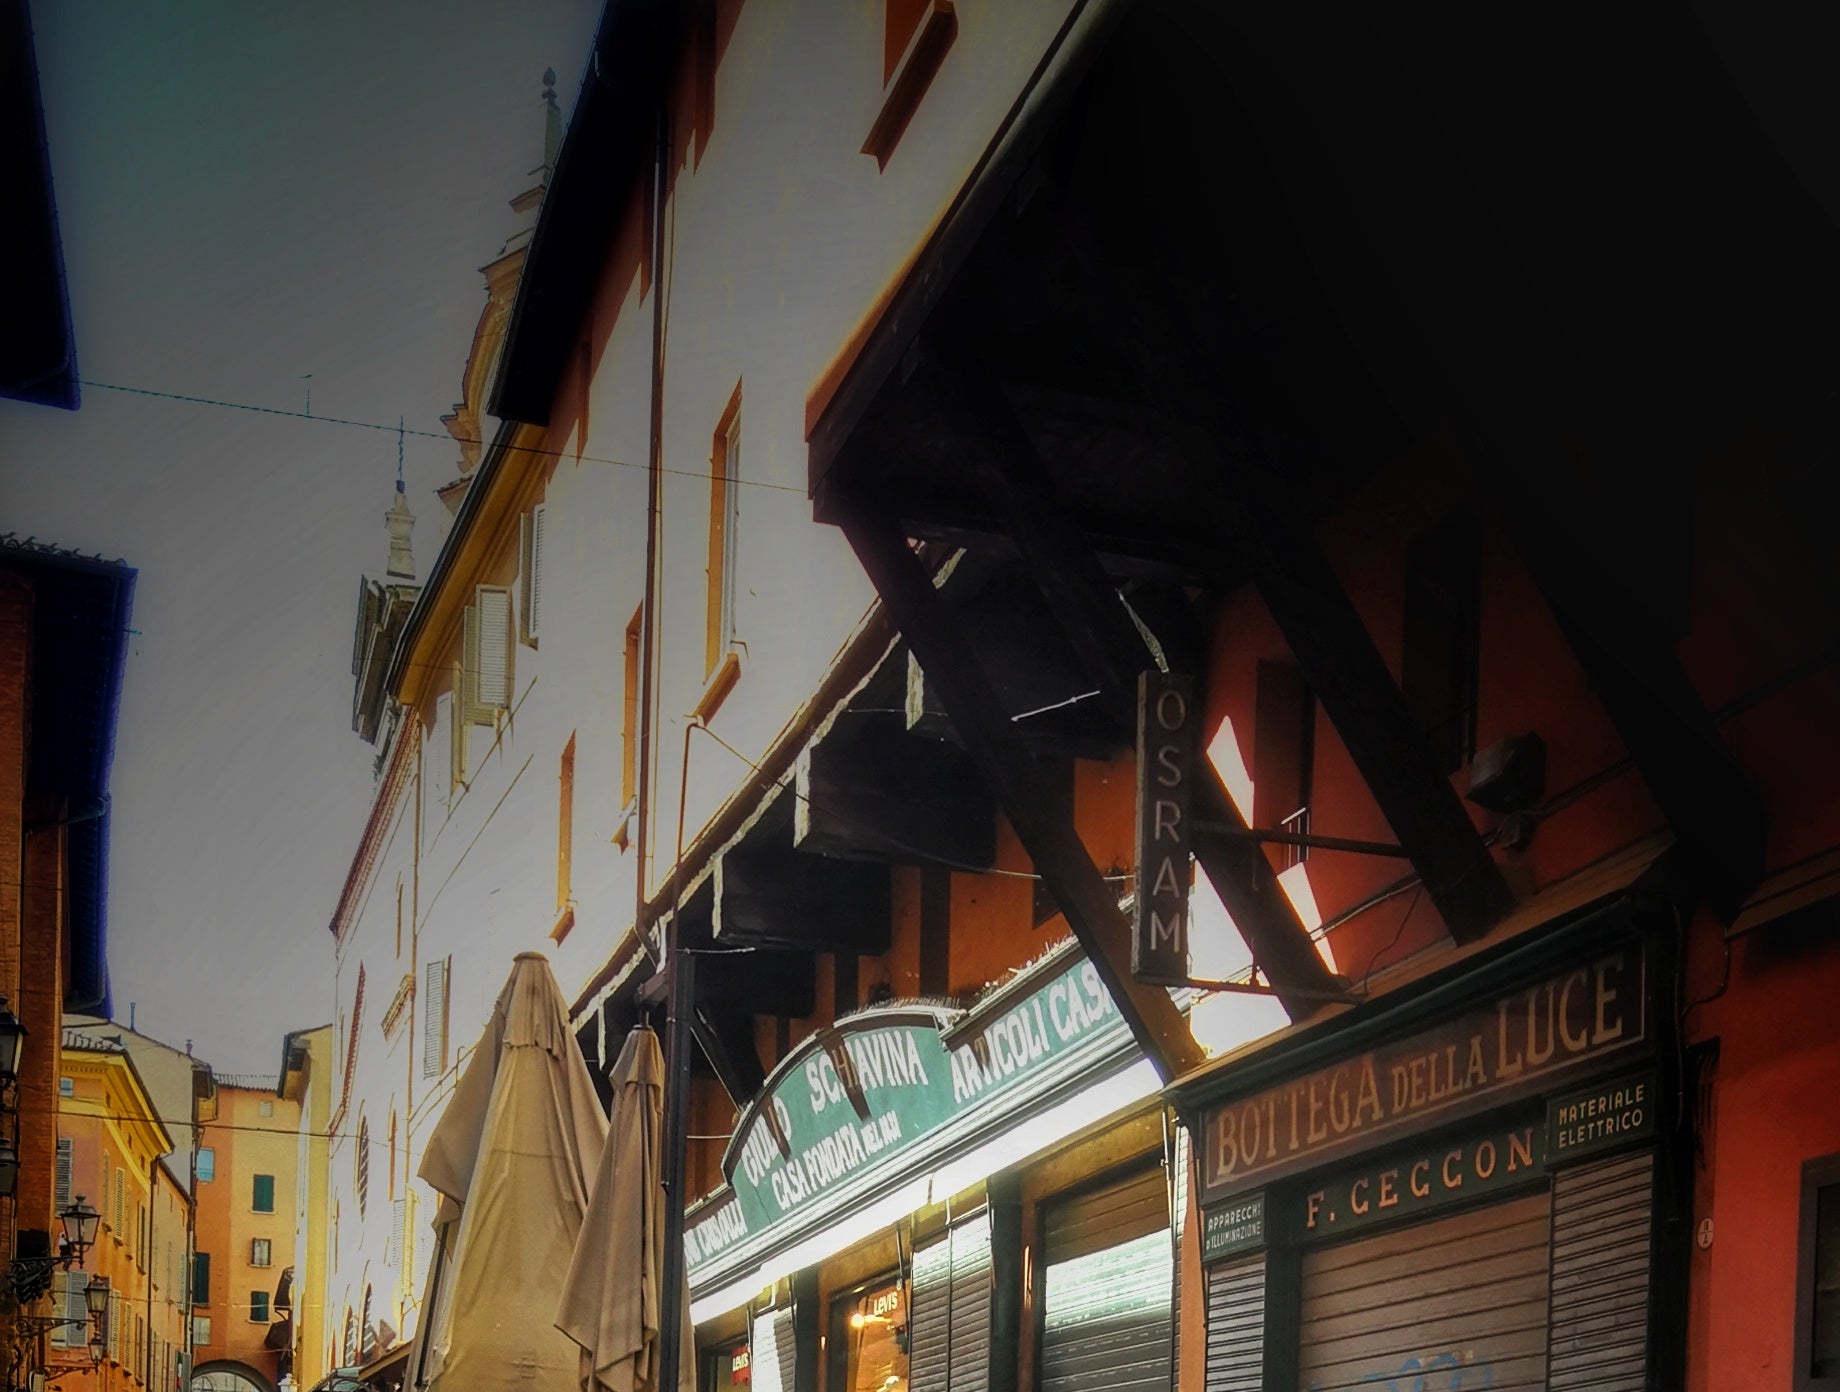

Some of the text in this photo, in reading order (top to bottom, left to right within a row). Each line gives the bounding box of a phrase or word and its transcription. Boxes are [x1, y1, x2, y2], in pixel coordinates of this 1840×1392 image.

[1149, 689, 1186, 954] OSRAM
[805, 1030, 929, 1114] SCHIAVINA
[950, 998, 1051, 1104] ARTICOLI
[1217, 952, 1625, 1179] BOTTEGA DELLA LUCE
[1558, 1084, 1645, 1126] MATERIALE
[1558, 1108, 1644, 1149] ELETTRICO
[771, 1158, 812, 1211] CASA
[802, 1122, 867, 1191] FONDATA
[1207, 1202, 1261, 1232] APPARECCHI
[1306, 1190, 1336, 1229] F.
